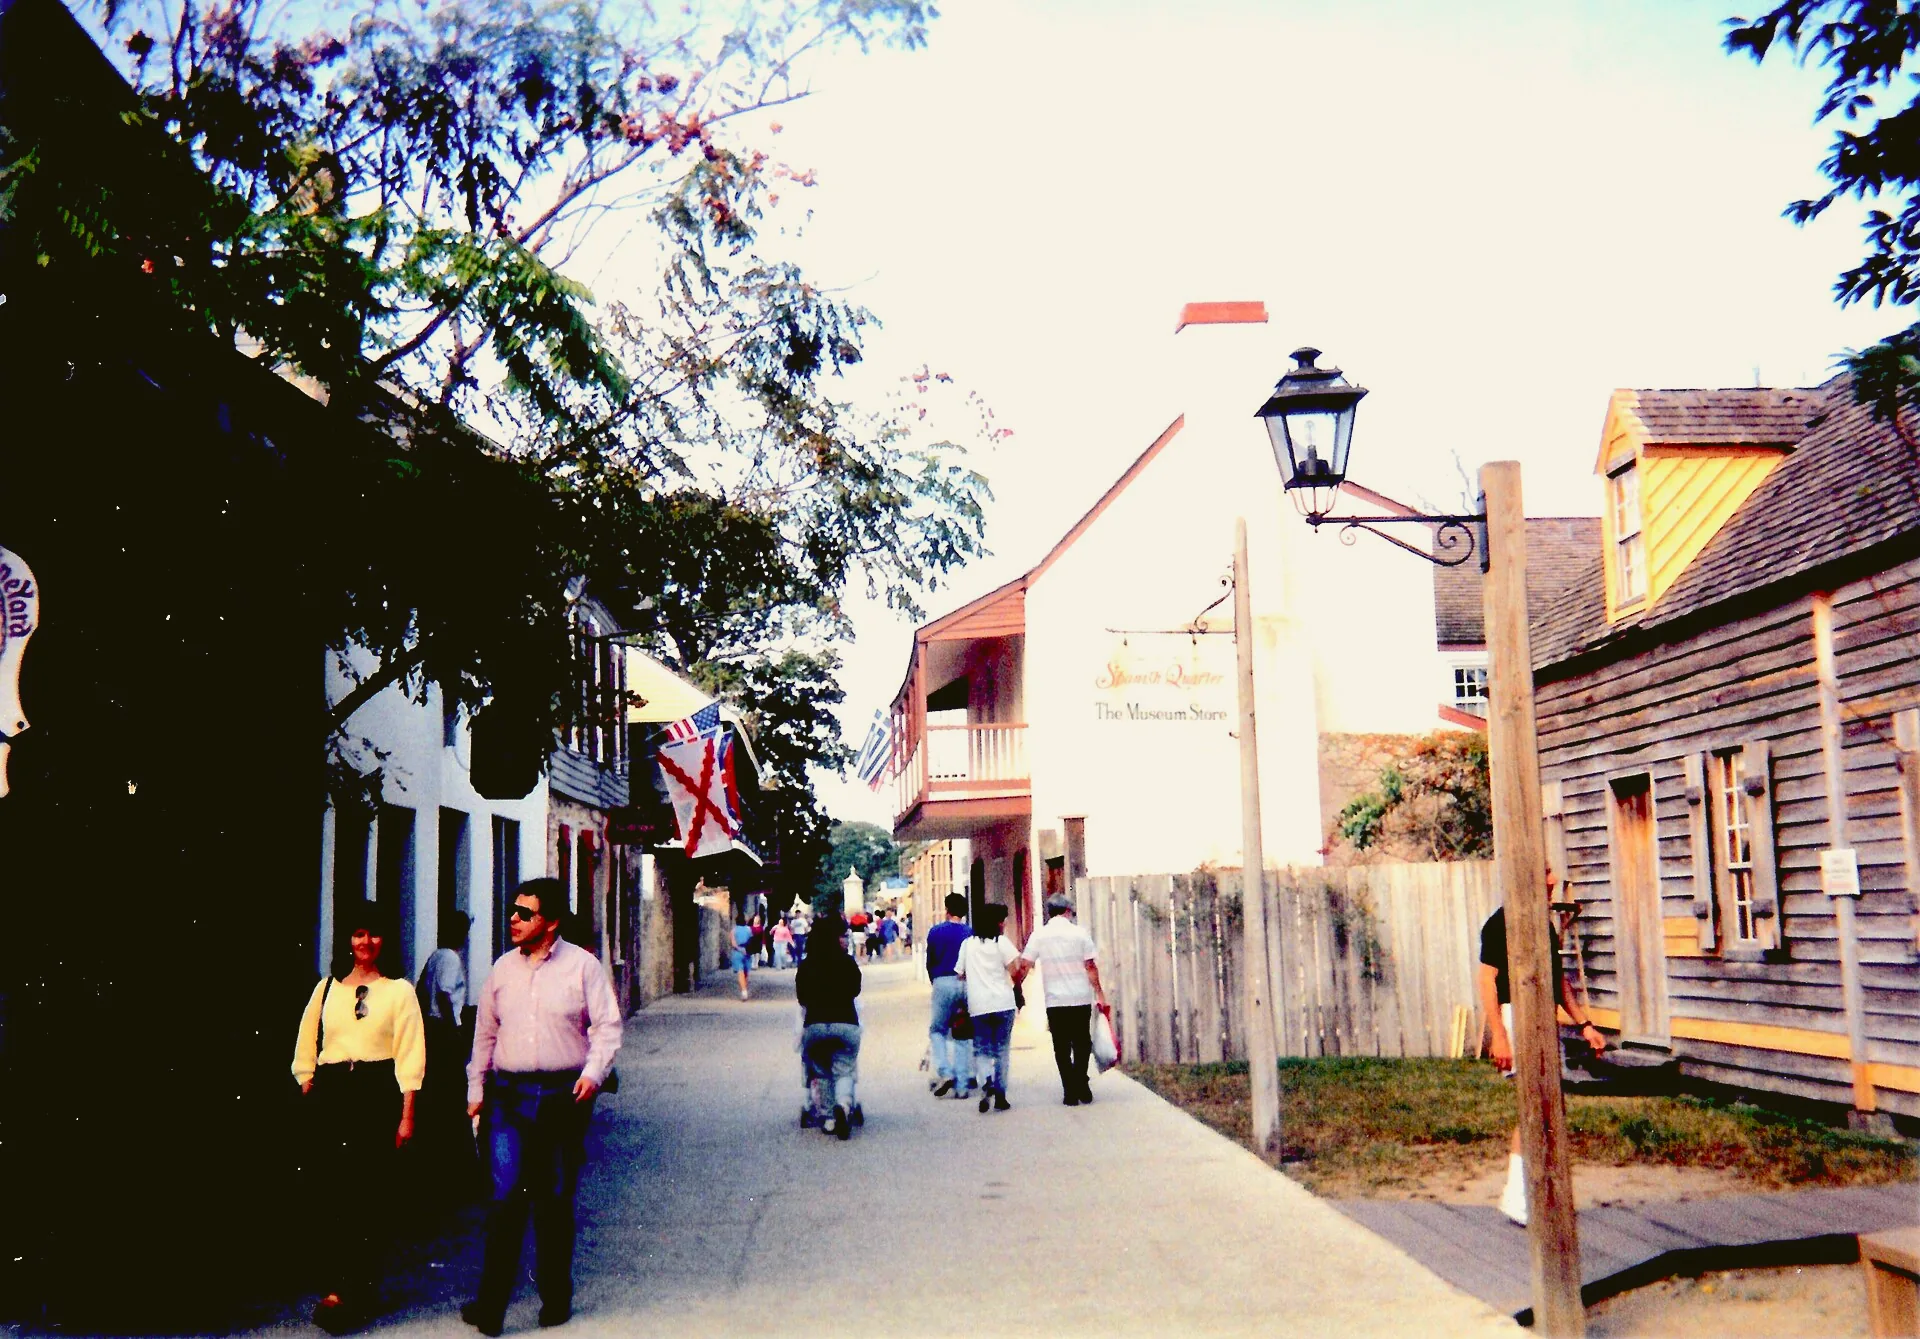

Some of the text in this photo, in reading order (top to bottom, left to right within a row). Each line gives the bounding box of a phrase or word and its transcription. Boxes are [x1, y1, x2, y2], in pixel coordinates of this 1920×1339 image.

[1165, 664, 1224, 689] Quarter
[1095, 702, 1227, 720] The Museum Store
